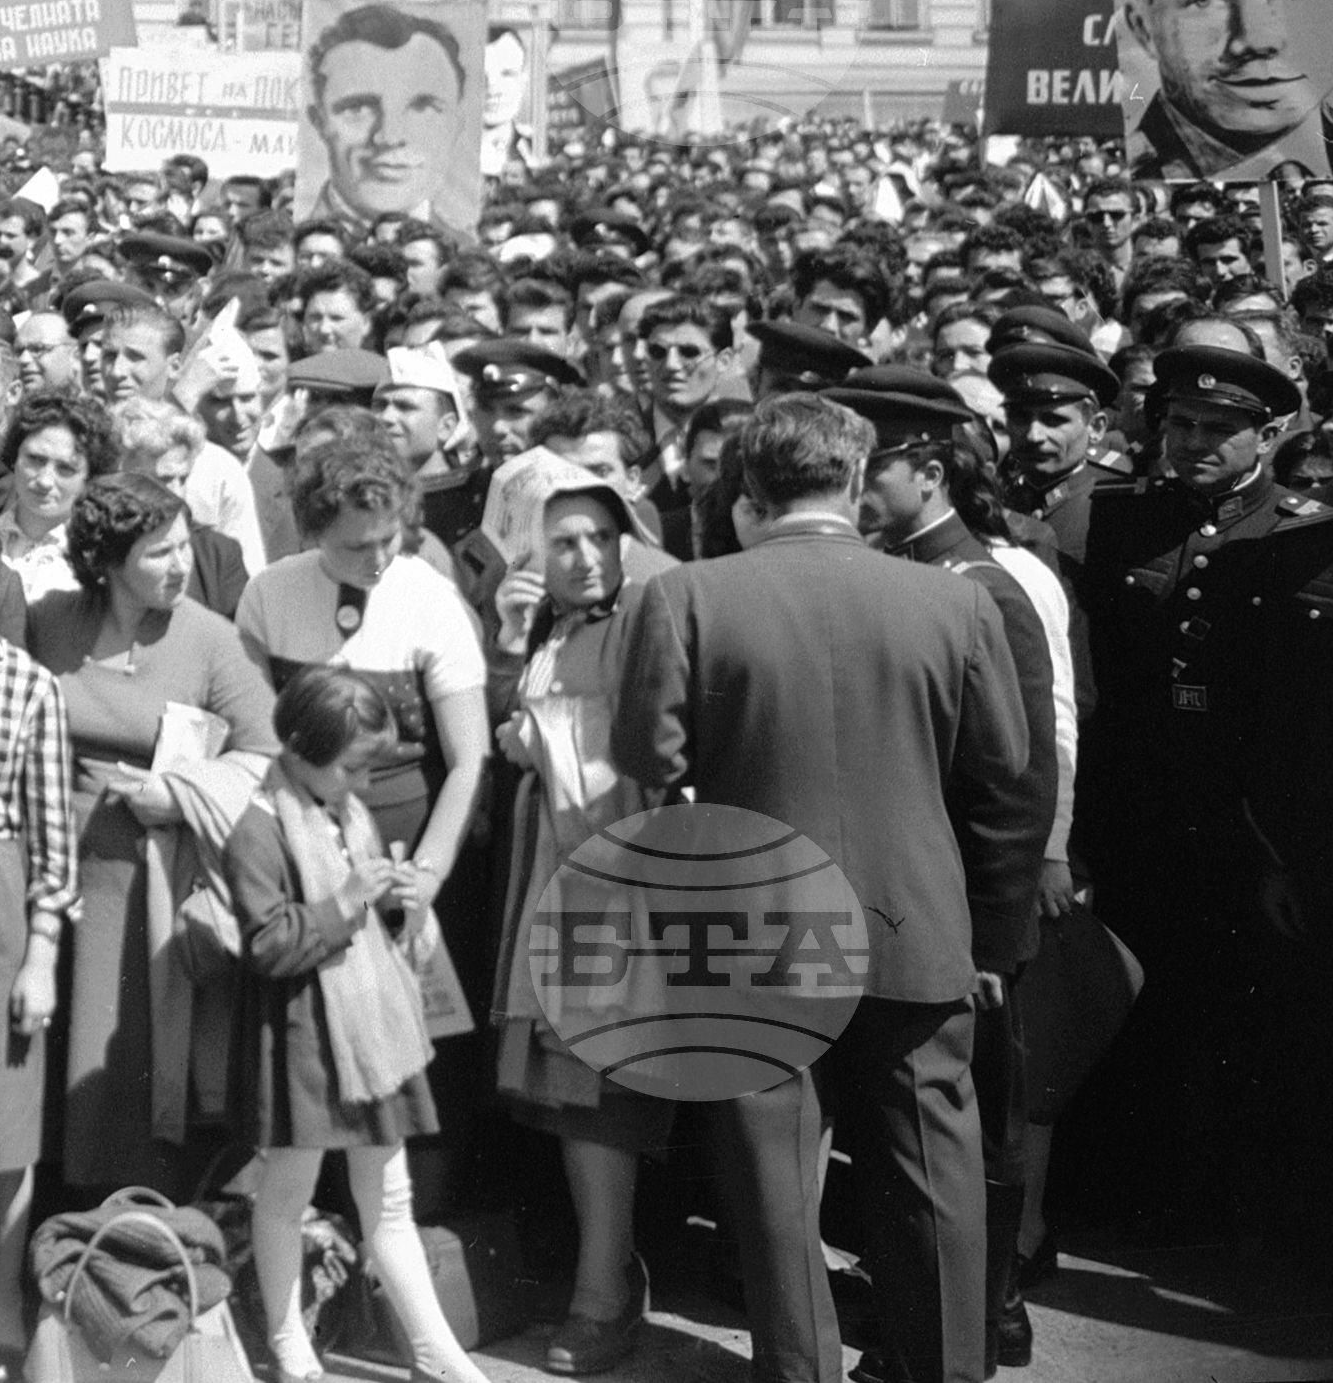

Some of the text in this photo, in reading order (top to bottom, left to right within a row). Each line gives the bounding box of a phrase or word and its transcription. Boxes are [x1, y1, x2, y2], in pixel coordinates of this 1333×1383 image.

[26, 27, 97, 57] НАУКА
[118, 67, 208, 105] ПРИВЕТ
[120, 115, 228, 152] КОСМОСА
